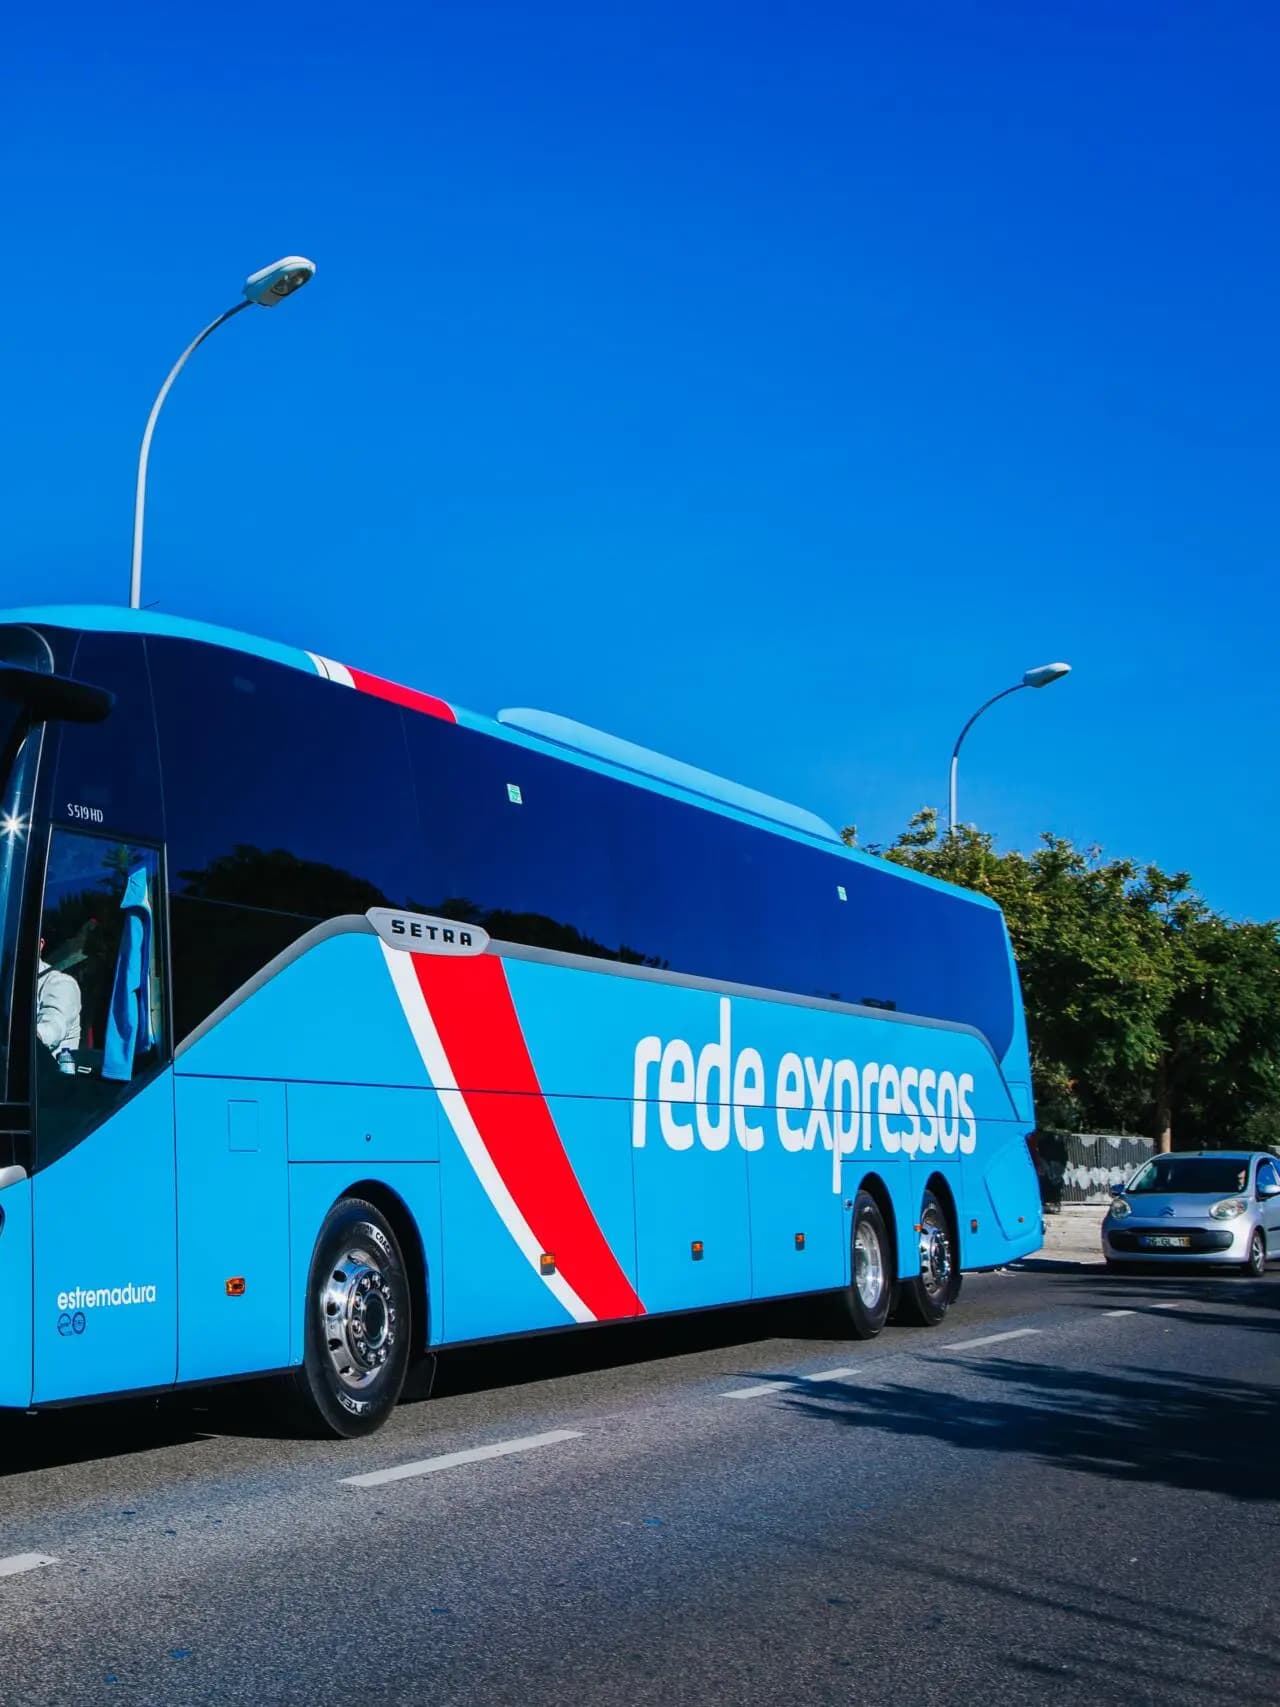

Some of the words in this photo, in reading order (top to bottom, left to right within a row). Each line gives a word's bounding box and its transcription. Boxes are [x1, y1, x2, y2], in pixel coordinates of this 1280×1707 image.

[391, 919, 472, 946] SETRA
[632, 998, 765, 1152] rede
[775, 1052, 977, 1194] expressos
[57, 1282, 156, 1310] estremadura
